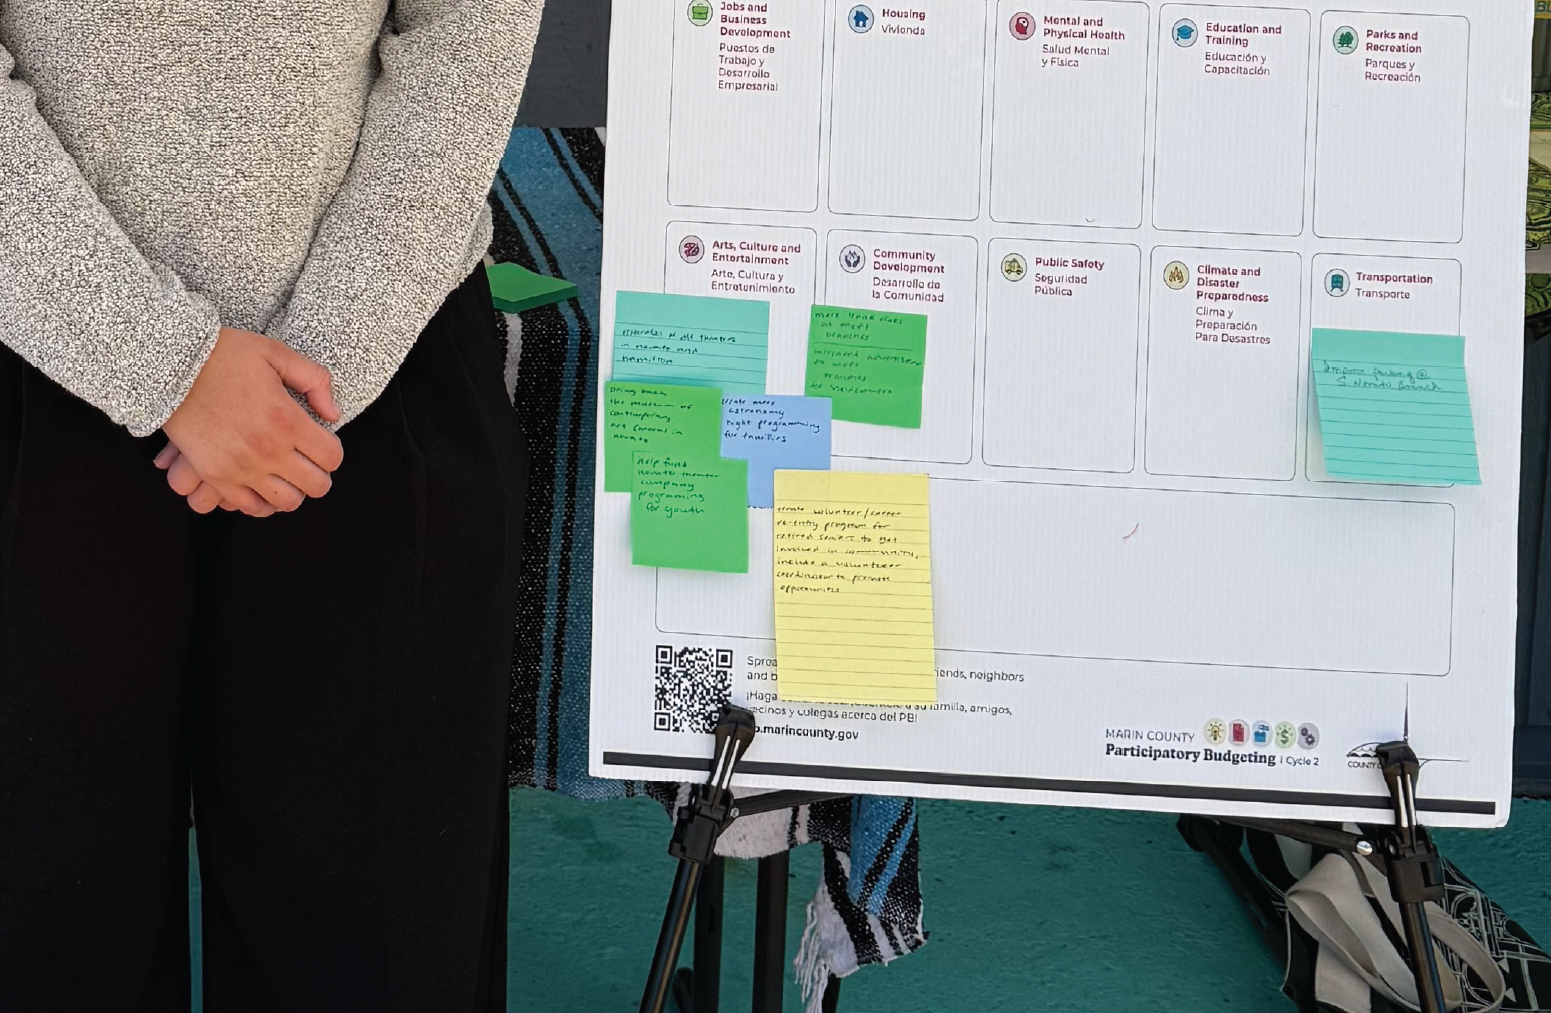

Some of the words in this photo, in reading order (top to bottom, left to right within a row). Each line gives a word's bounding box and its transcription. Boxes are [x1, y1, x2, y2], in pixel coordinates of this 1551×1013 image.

[882, 8, 926, 21] Housing
[1206, 22, 1259, 34] Education
[1262, 25, 1282, 35] and
[1366, 29, 1397, 40] Parks
[1398, 31, 1418, 41] and
[1205, 34, 1249, 48] Training
[1365, 42, 1422, 54] Recreation
[1356, 271, 1433, 285] Transportation
[1355, 287, 1411, 300] Transporte
[1105, 742, 1200, 763] Participatory
[1203, 748, 1277, 767] Budgeting
